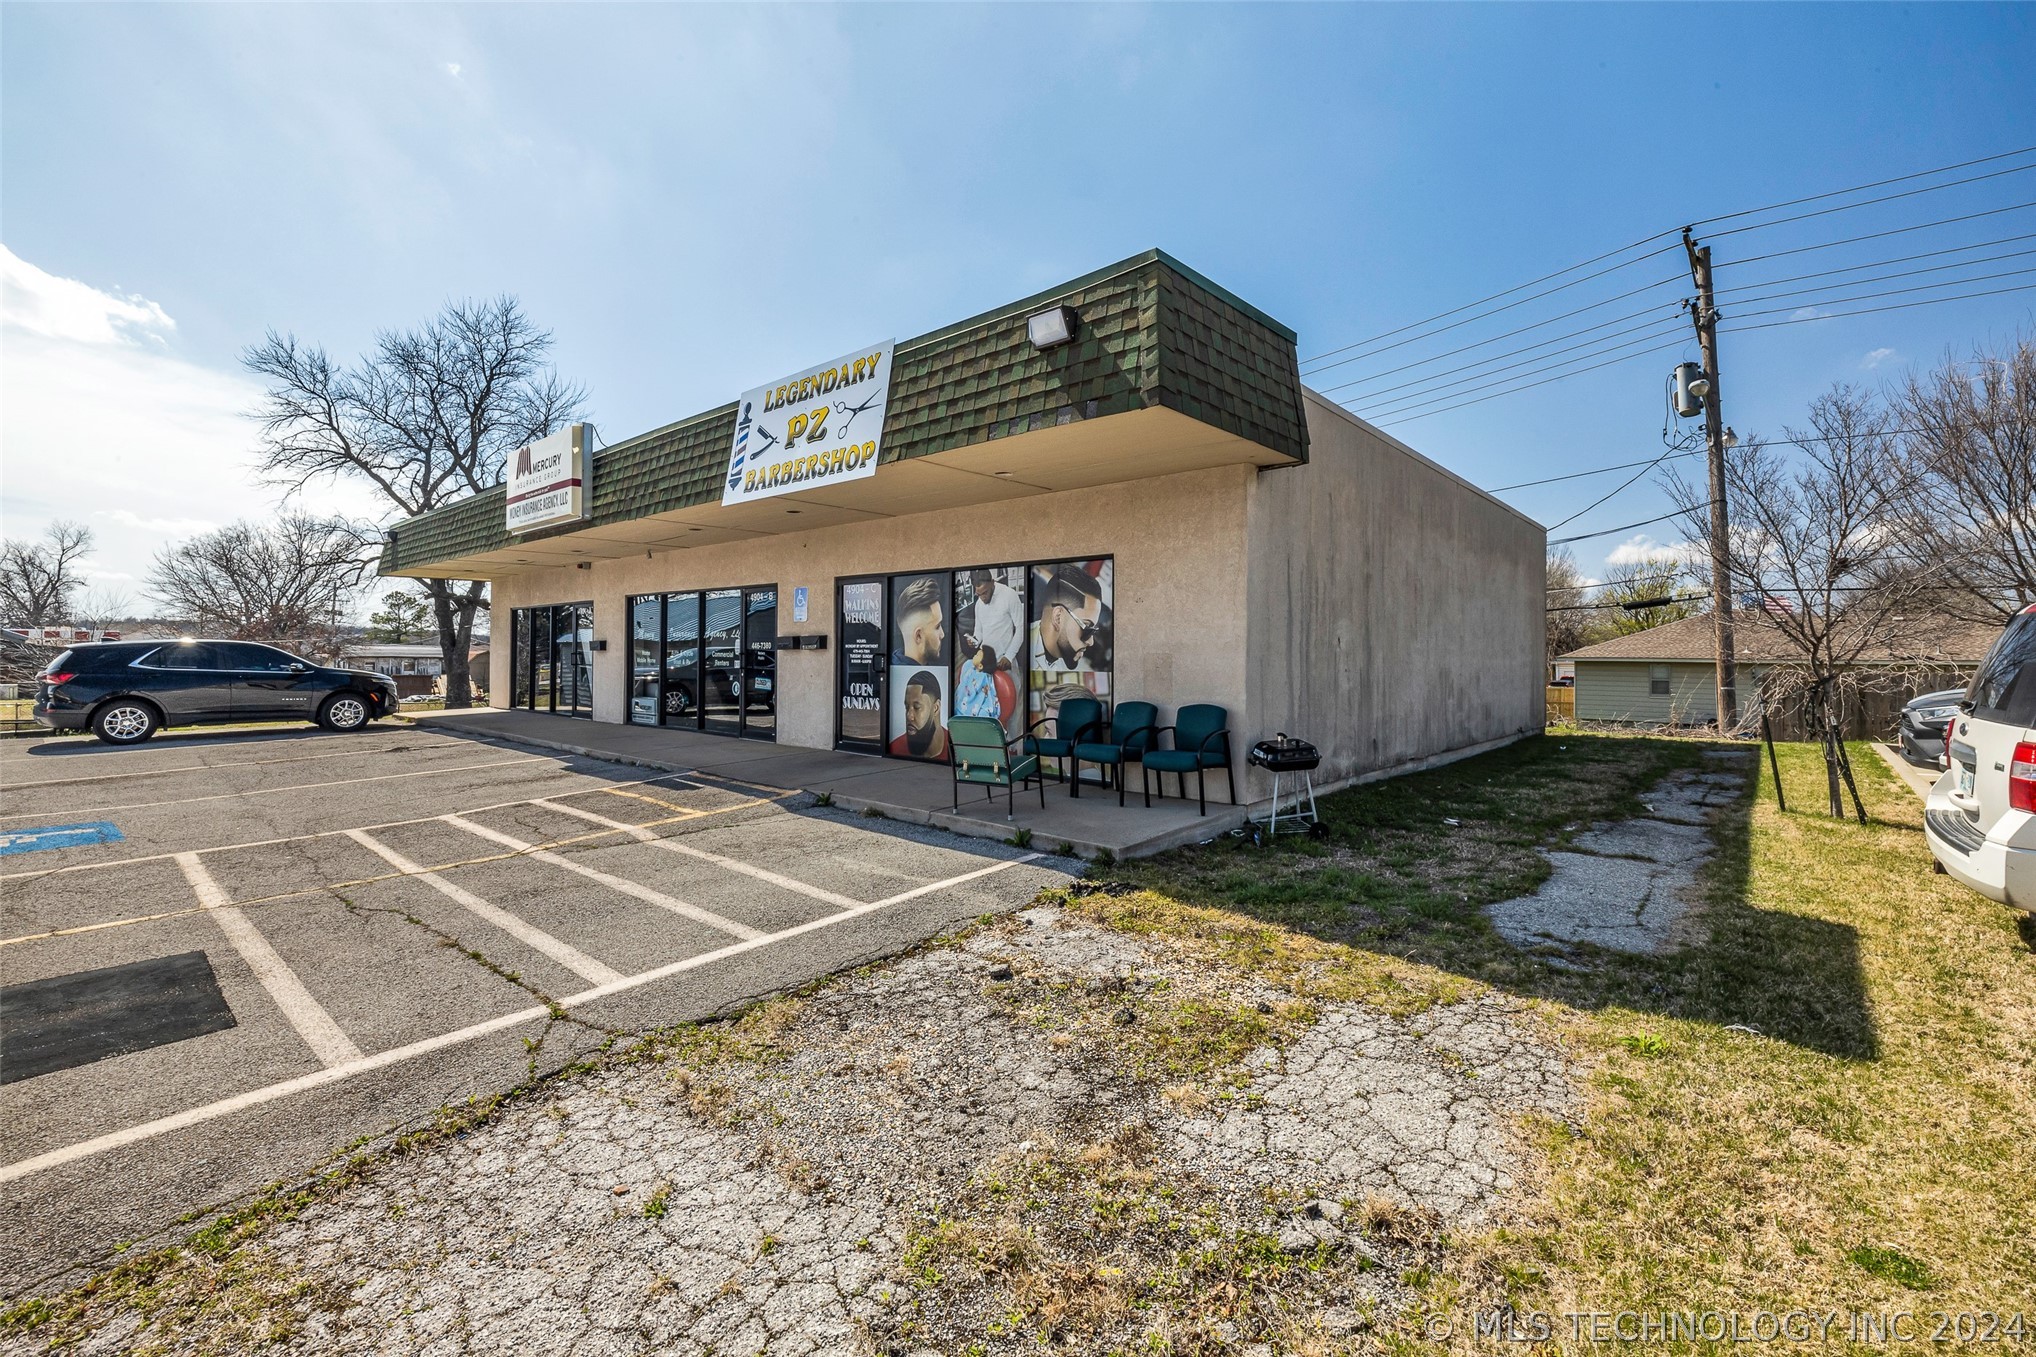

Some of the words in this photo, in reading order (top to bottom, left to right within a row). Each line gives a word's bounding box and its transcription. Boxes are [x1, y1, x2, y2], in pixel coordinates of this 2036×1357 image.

[763, 351, 882, 413] LEGENDARY
[784, 405, 830, 450] PZ
[532, 453, 562, 474] MERCURY
[743, 440, 876, 493] BARBERSHOP
[515, 475, 542, 489] INSURANCE
[544, 468, 561, 480] GROUP
[521, 499, 543, 517] INSURANCE
[560, 491, 568, 506] LLC
[845, 611, 880, 624] WELCOME
[711, 650, 734, 658] Commercial
[714, 659, 730, 667] Renters
[850, 682, 874, 697] OPEN
[842, 696, 880, 711] SUNDAYS
